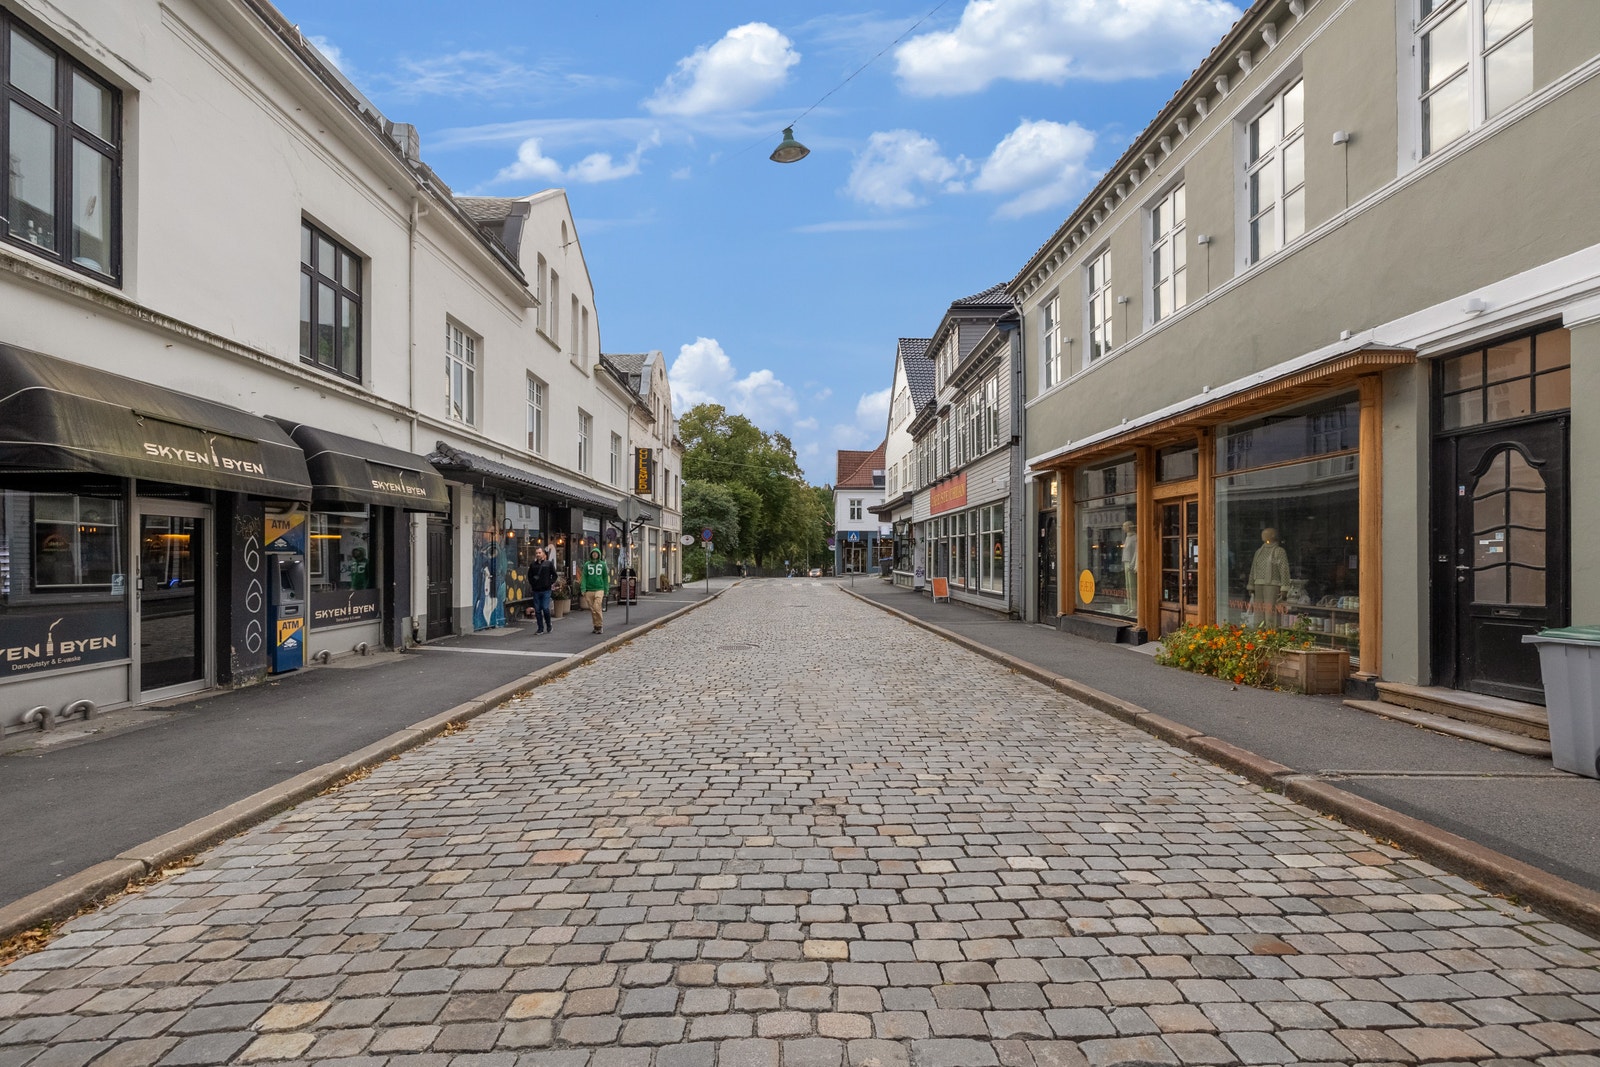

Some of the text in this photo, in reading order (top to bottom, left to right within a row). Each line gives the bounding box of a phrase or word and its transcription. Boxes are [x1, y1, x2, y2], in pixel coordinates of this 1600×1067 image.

[143, 442, 264, 475] SKYEN BYEN
[371, 480, 427, 496] SKYEN BYEN
[271, 520, 291, 530] ATM
[587, 564, 603, 575] 56
[314, 606, 347, 619] SKYEN
[353, 603, 375, 614] BYEN
[282, 620, 299, 630] ATM
[60, 634, 117, 654] BYEN
[11, 659, 50, 671] Damputstyr
